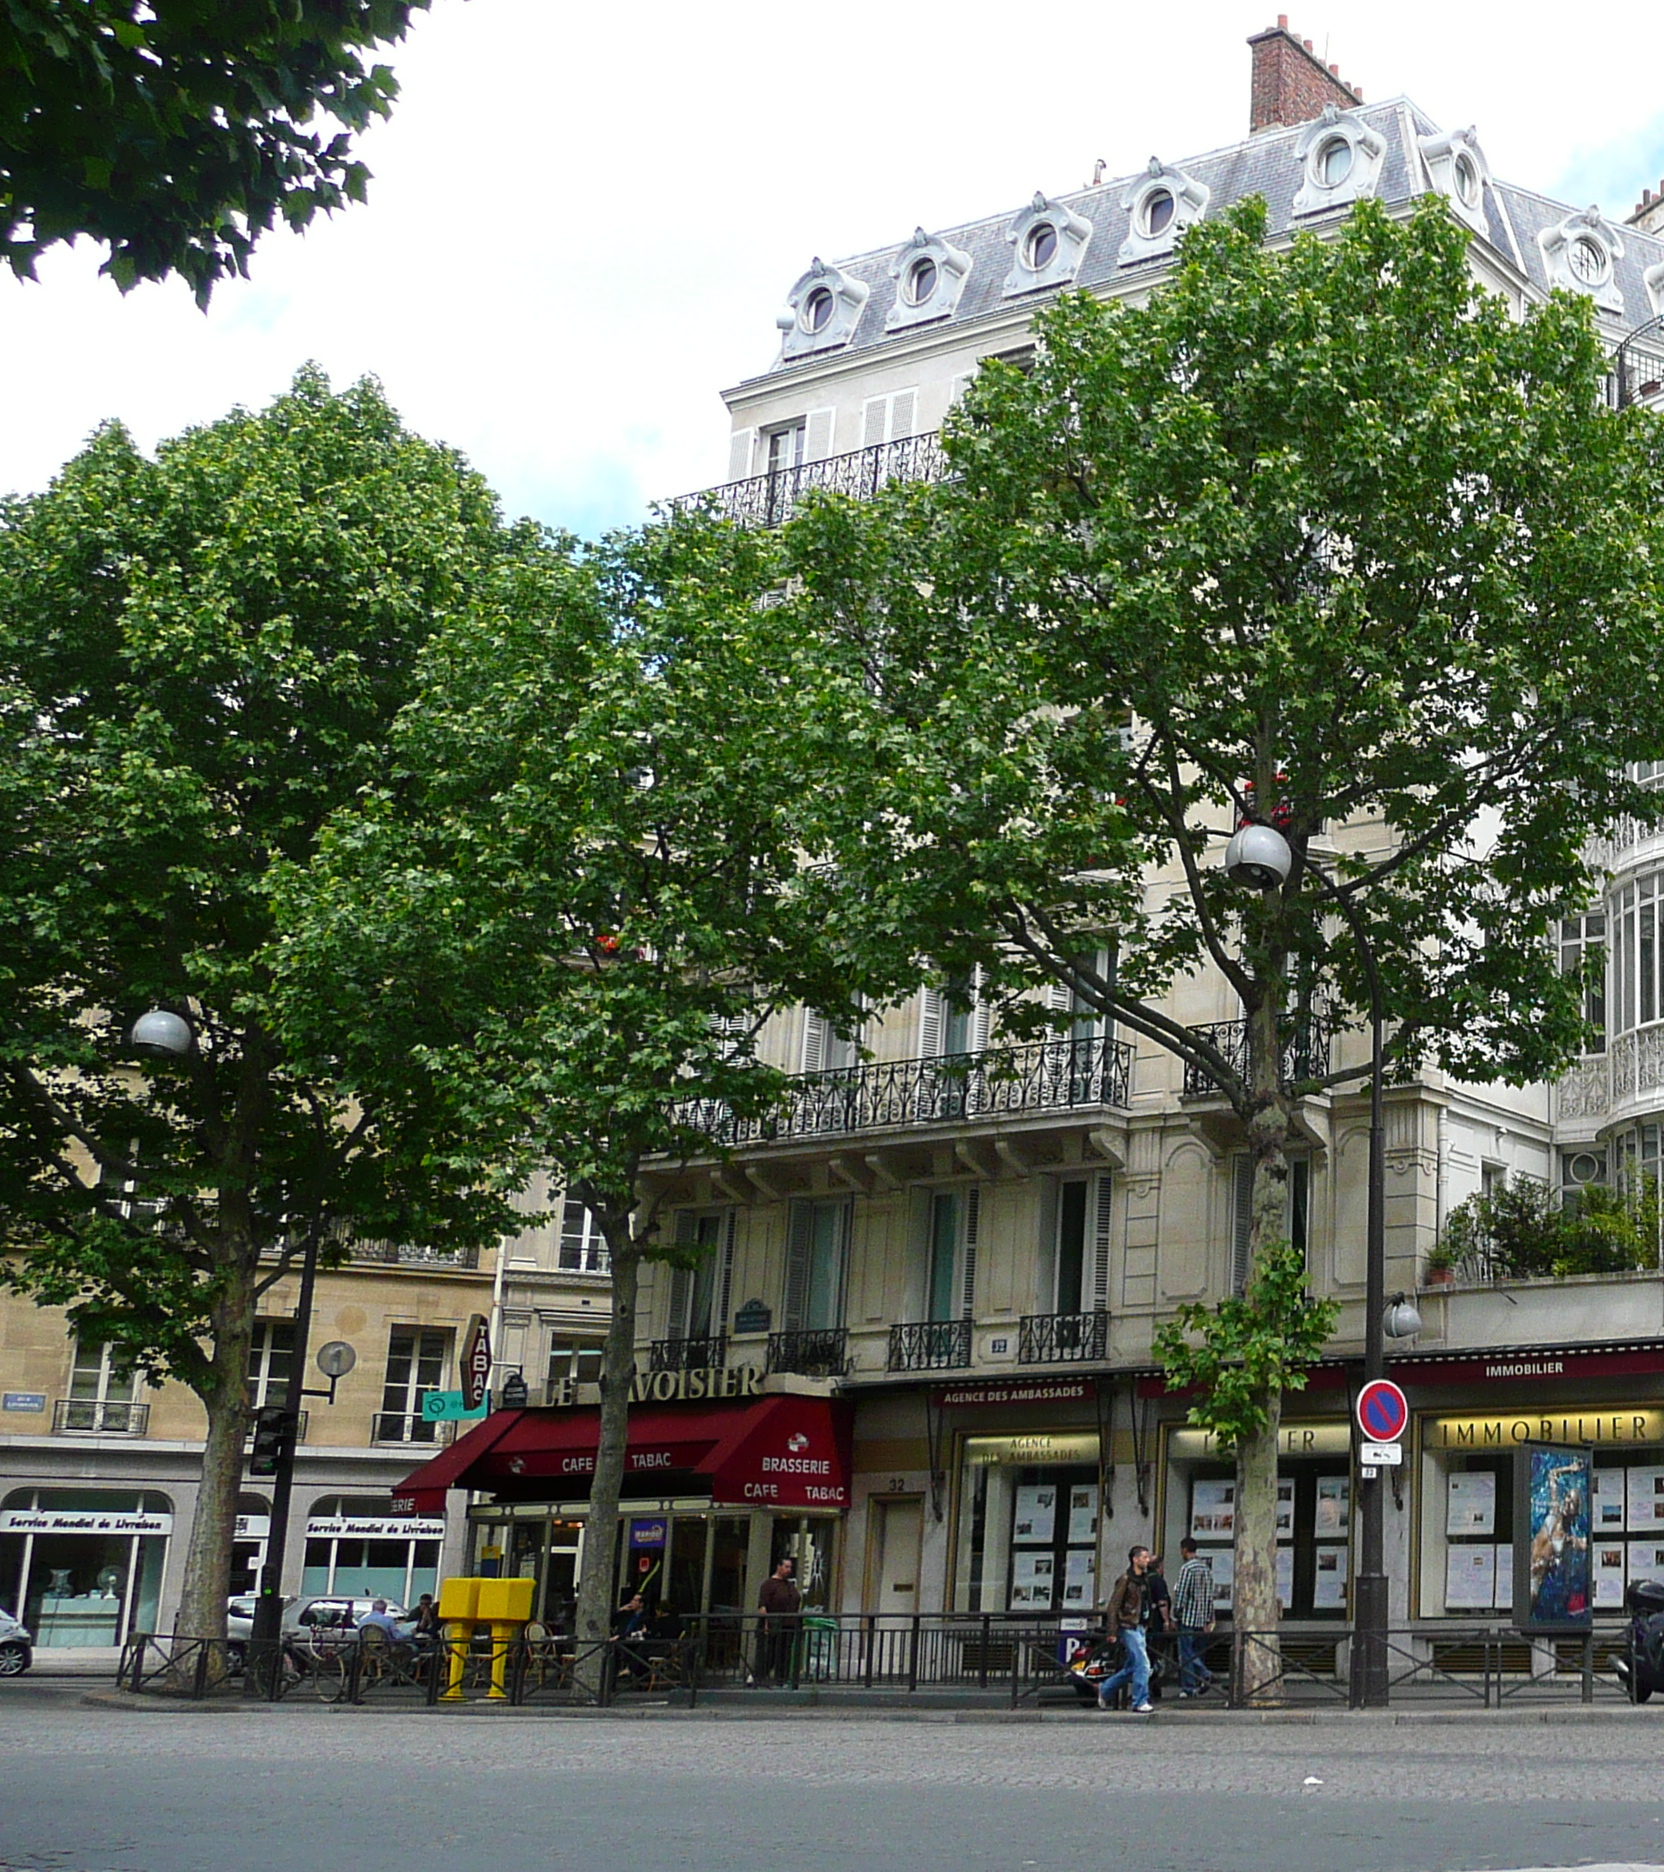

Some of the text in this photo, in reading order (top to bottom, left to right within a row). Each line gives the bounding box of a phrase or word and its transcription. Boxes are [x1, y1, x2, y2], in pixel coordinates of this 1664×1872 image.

[473, 1325, 489, 1401] TABAC
[1486, 1362, 1564, 1377] IMMOBILIER
[540, 1366, 765, 1407] LE VOISIER
[944, 1386, 1084, 1404] AGENCE DES AMBASSADES
[1443, 1416, 1647, 1446] IMMOBILIER
[1010, 1438, 1052, 1449] AGENCE
[562, 1453, 672, 1472] CAFE TABAC
[1008, 1449, 1080, 1462] AMBASSADES
[762, 1457, 830, 1474] BRASSERIE
[744, 1482, 845, 1500] CAFE TABAC
[889, 1478, 905, 1492] 32
[9, 1516, 162, 1530] Service Mondial de Livraison
[307, 1523, 444, 1534] Service Mondial de Livraison
